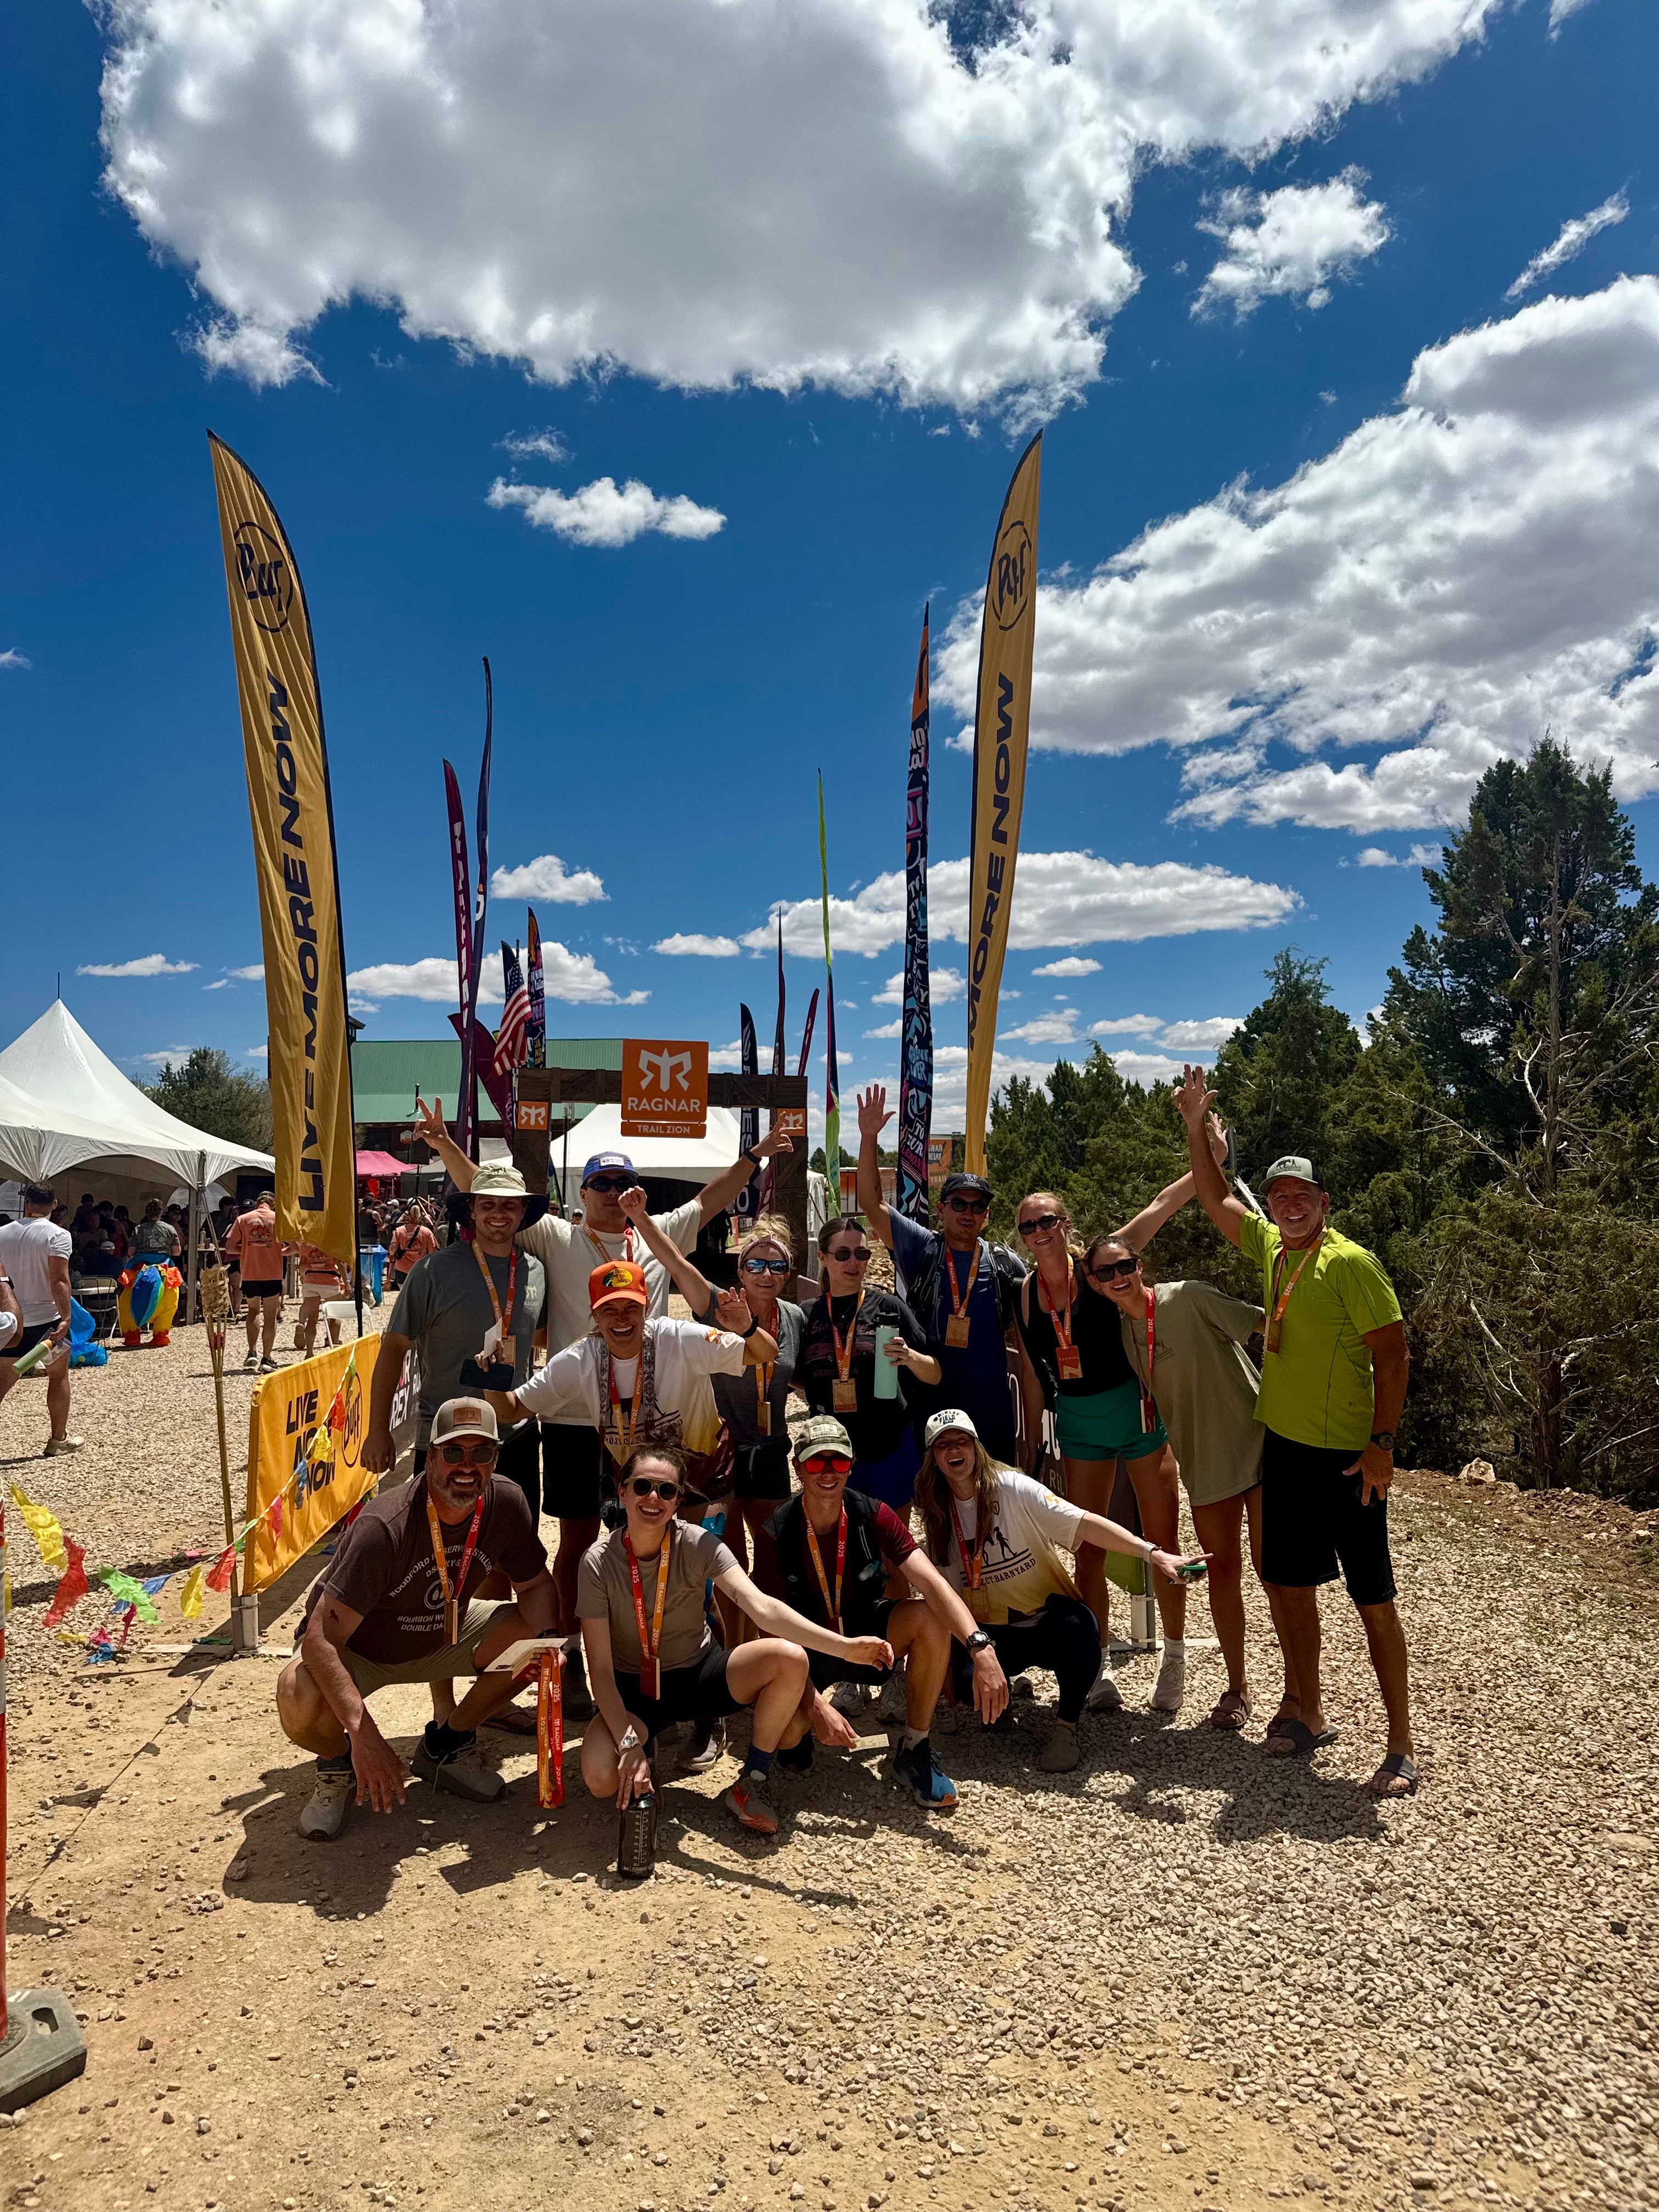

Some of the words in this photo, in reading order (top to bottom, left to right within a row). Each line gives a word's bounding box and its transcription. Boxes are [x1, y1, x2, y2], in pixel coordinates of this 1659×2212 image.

[266, 666, 303, 849] NOW
[992, 671, 1014, 845] NOW
[283, 852, 320, 1061] MORE
[627, 1097, 701, 1113] RAGNAR
[637, 1125, 664, 1133] TRAIL
[665, 1126, 691, 1134] ZION
[298, 1068, 324, 1211] LIVE
[928, 1144, 943, 1152] GNAR
[485, 1276, 494, 1290] 2025
[1284, 1282, 1294, 1296] 2025
[1051, 1310, 1059, 1322] 2025
[1058, 1332, 1068, 1349] RAGNAR
[286, 1389, 318, 1436] LIVE
[471, 1514, 480, 1532] 2025
[433, 1530, 441, 1553] RAGNAR
[459, 1553, 471, 1579] RAGNAR
[661, 1549, 669, 1567] 2025
[814, 1549, 823, 1571] RAGNAR
[387, 1557, 430, 1598] WOODFORD
[439, 1567, 447, 1585] 2025
[631, 1565, 640, 1584] 2025
[636, 1606, 645, 1629] RAGNAR
[400, 1623, 431, 1632] DOUBLE
